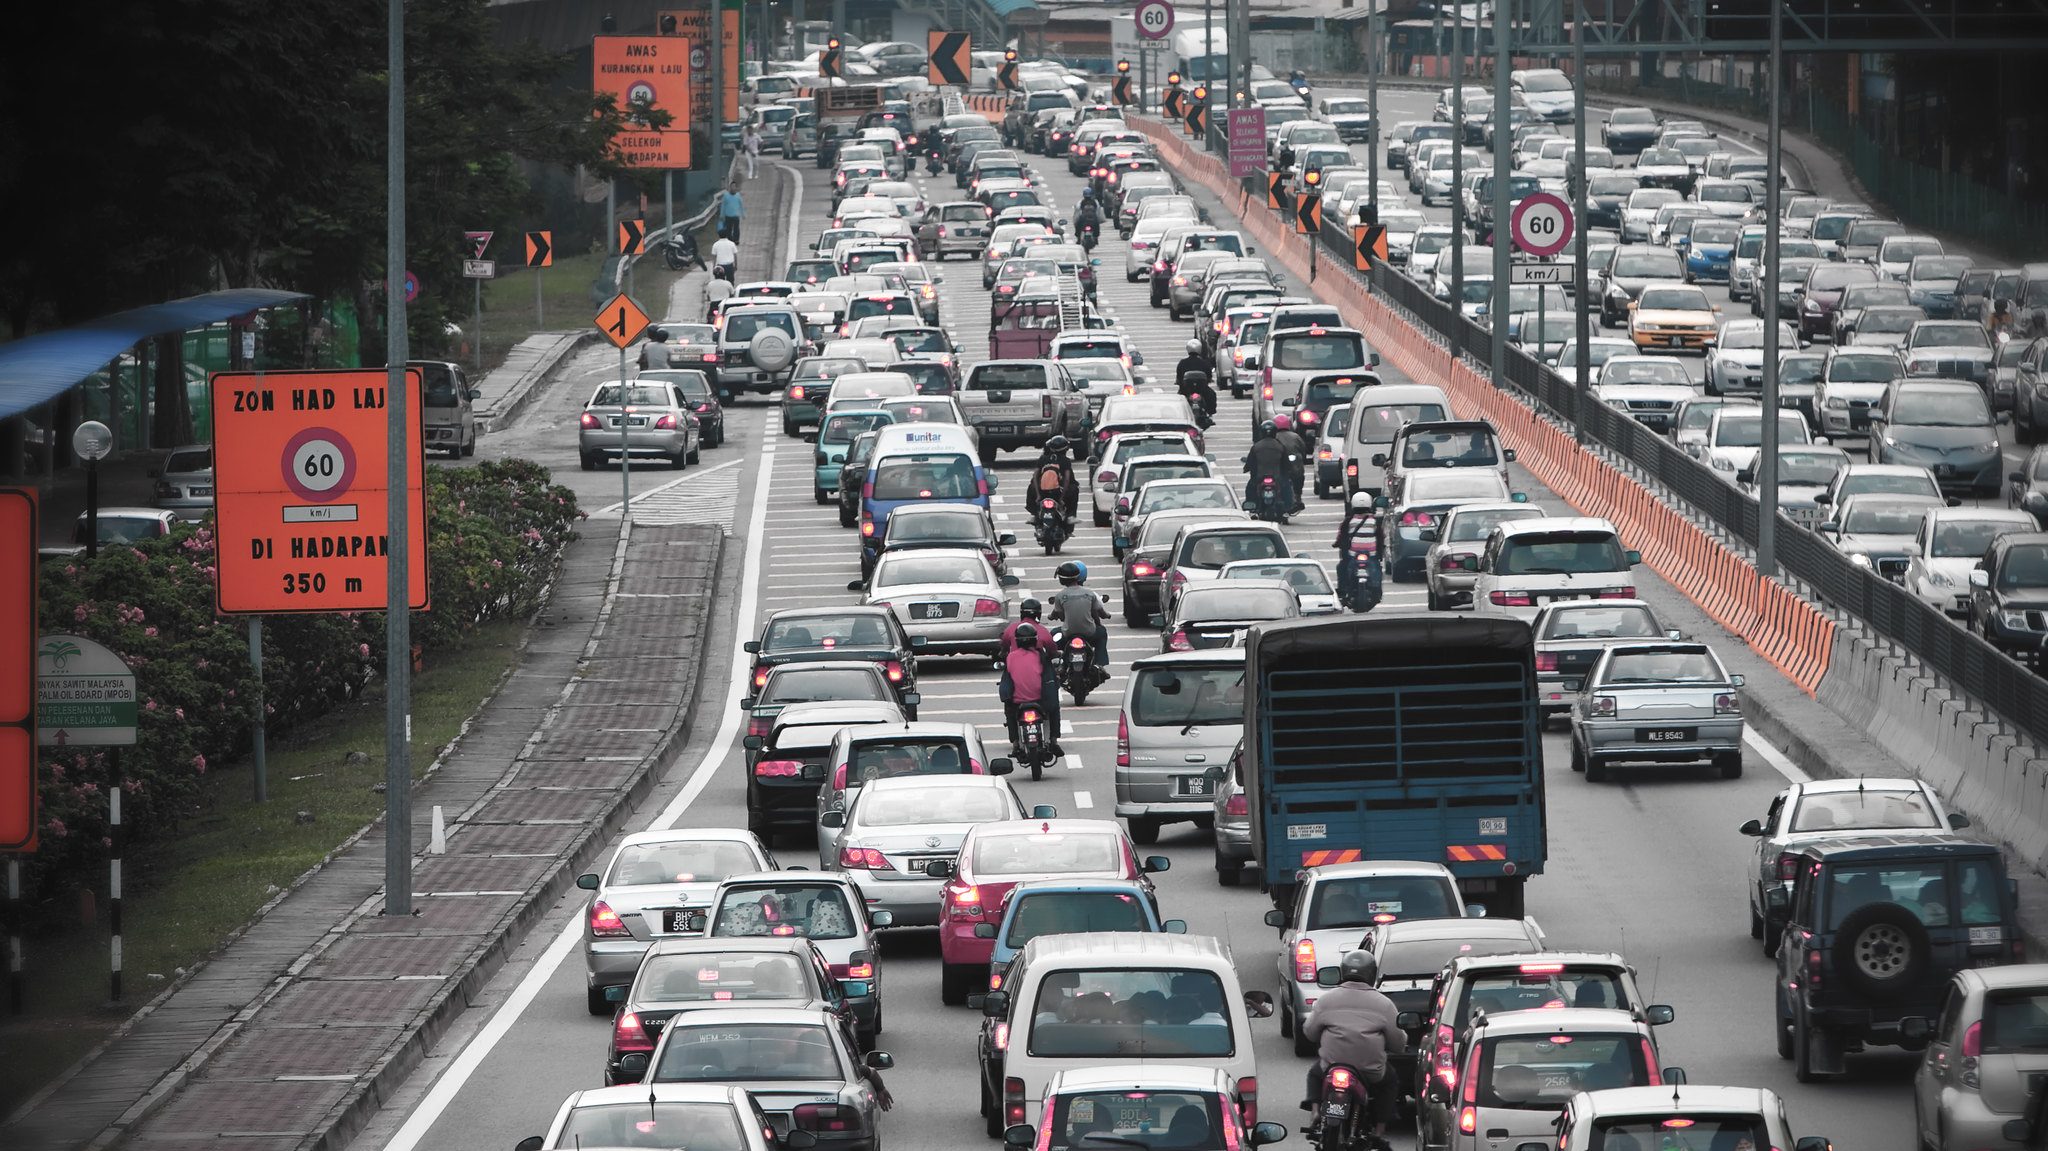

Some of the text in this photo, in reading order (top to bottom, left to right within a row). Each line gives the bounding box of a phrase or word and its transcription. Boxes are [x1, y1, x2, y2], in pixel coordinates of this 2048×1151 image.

[1145, 11, 1164, 25] 60
[626, 45, 657, 57] AWAS
[601, 64, 682, 74] KURANGKAN LAJU
[1236, 115, 1258, 125] AWAS
[621, 137, 662, 147] SELEKOH
[627, 152, 669, 162] ADAPAN
[1530, 216, 1555, 234] 60
[1525, 268, 1560, 280] km/j
[234, 388, 385, 412] ZON HAD LAJ
[914, 432, 942, 441] unitar
[304, 453, 334, 477] 60
[310, 508, 331, 519] km/j
[252, 535, 389, 559] DI HADAPAN
[283, 573, 362, 594] 350 m
[63, 680, 85, 689] SAWIT
[88, 680, 124, 689] MALAYSIA
[61, 690, 73, 699] OIL
[75, 690, 102, 699] BOARD
[104, 690, 131, 700] (MPOB)
[96, 705, 111, 714] DAN
[64, 716, 96, 724] KELANA
[99, 716, 117, 724] JAYA
[1648, 731, 1684, 740] WLE 8543
